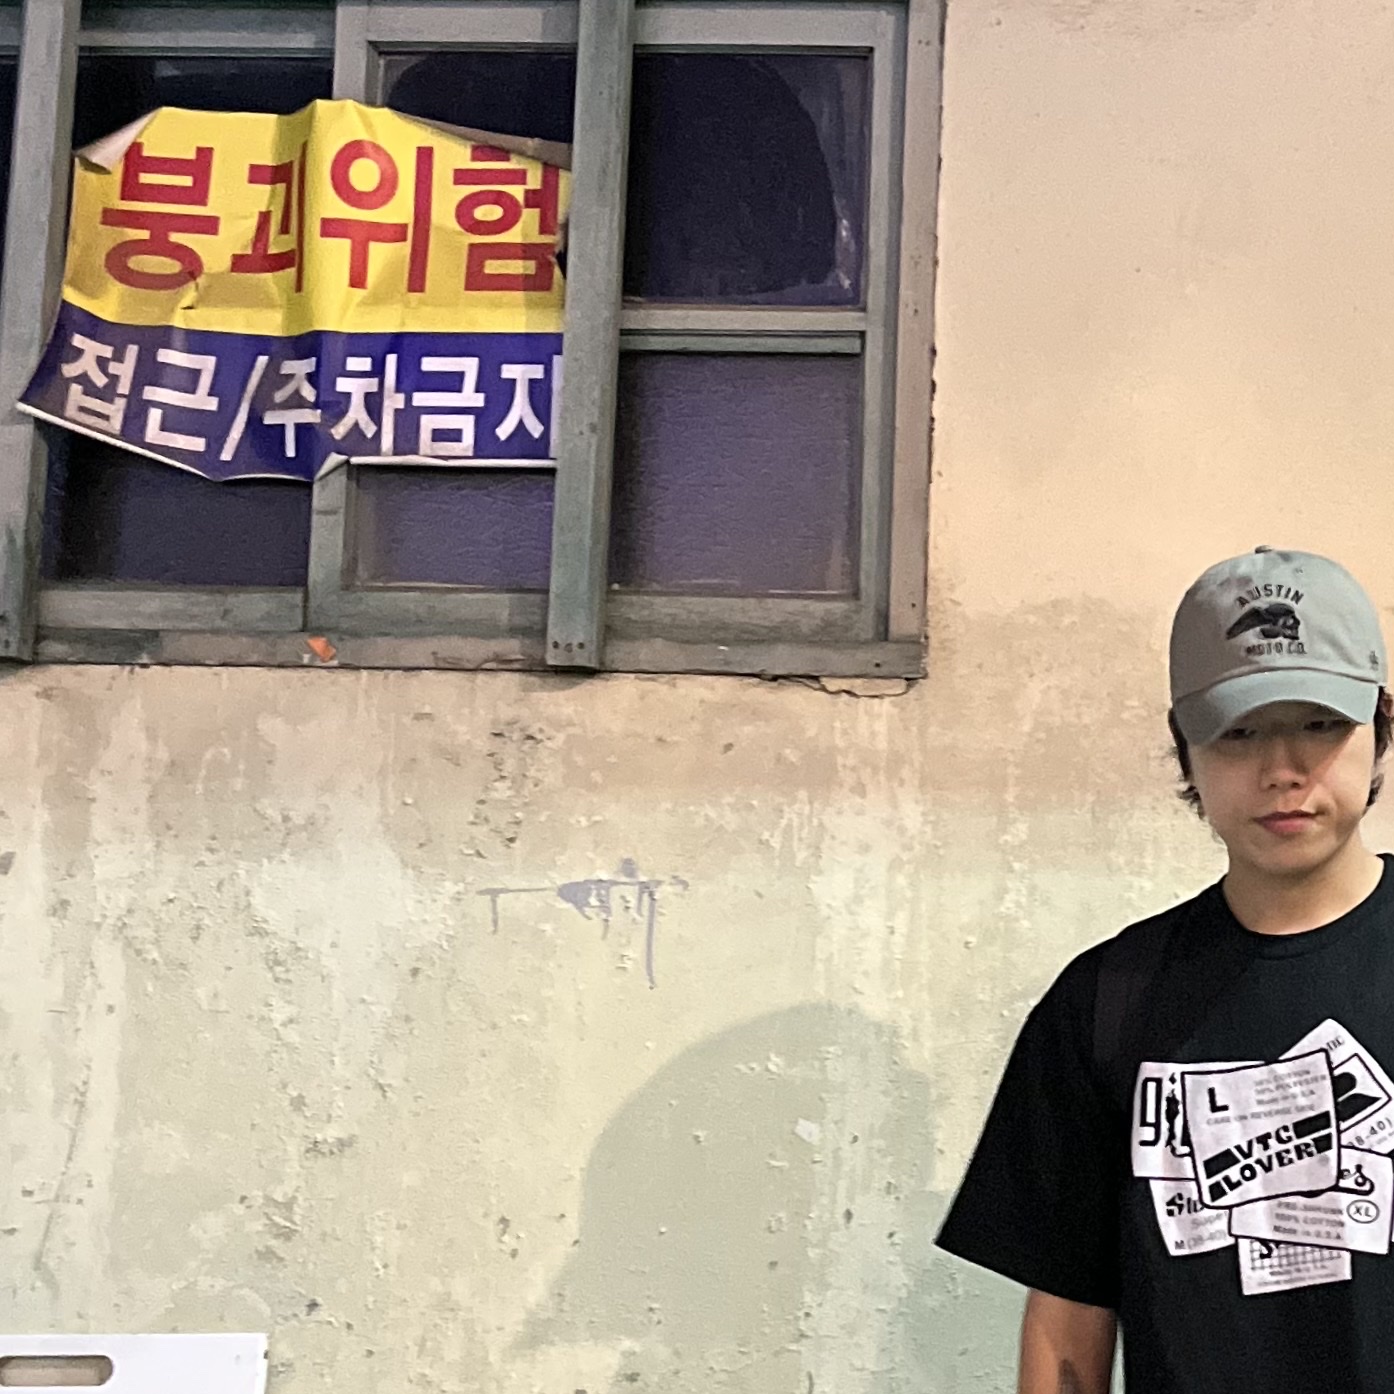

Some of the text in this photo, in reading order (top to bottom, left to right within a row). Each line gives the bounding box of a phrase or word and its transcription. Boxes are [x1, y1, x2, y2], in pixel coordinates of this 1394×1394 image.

[1236, 583, 1304, 608] AUSTIN
[1207, 1086, 1230, 1113] L
[1222, 1142, 1316, 1191] LOVER
[1354, 1204, 1373, 1218] XL
